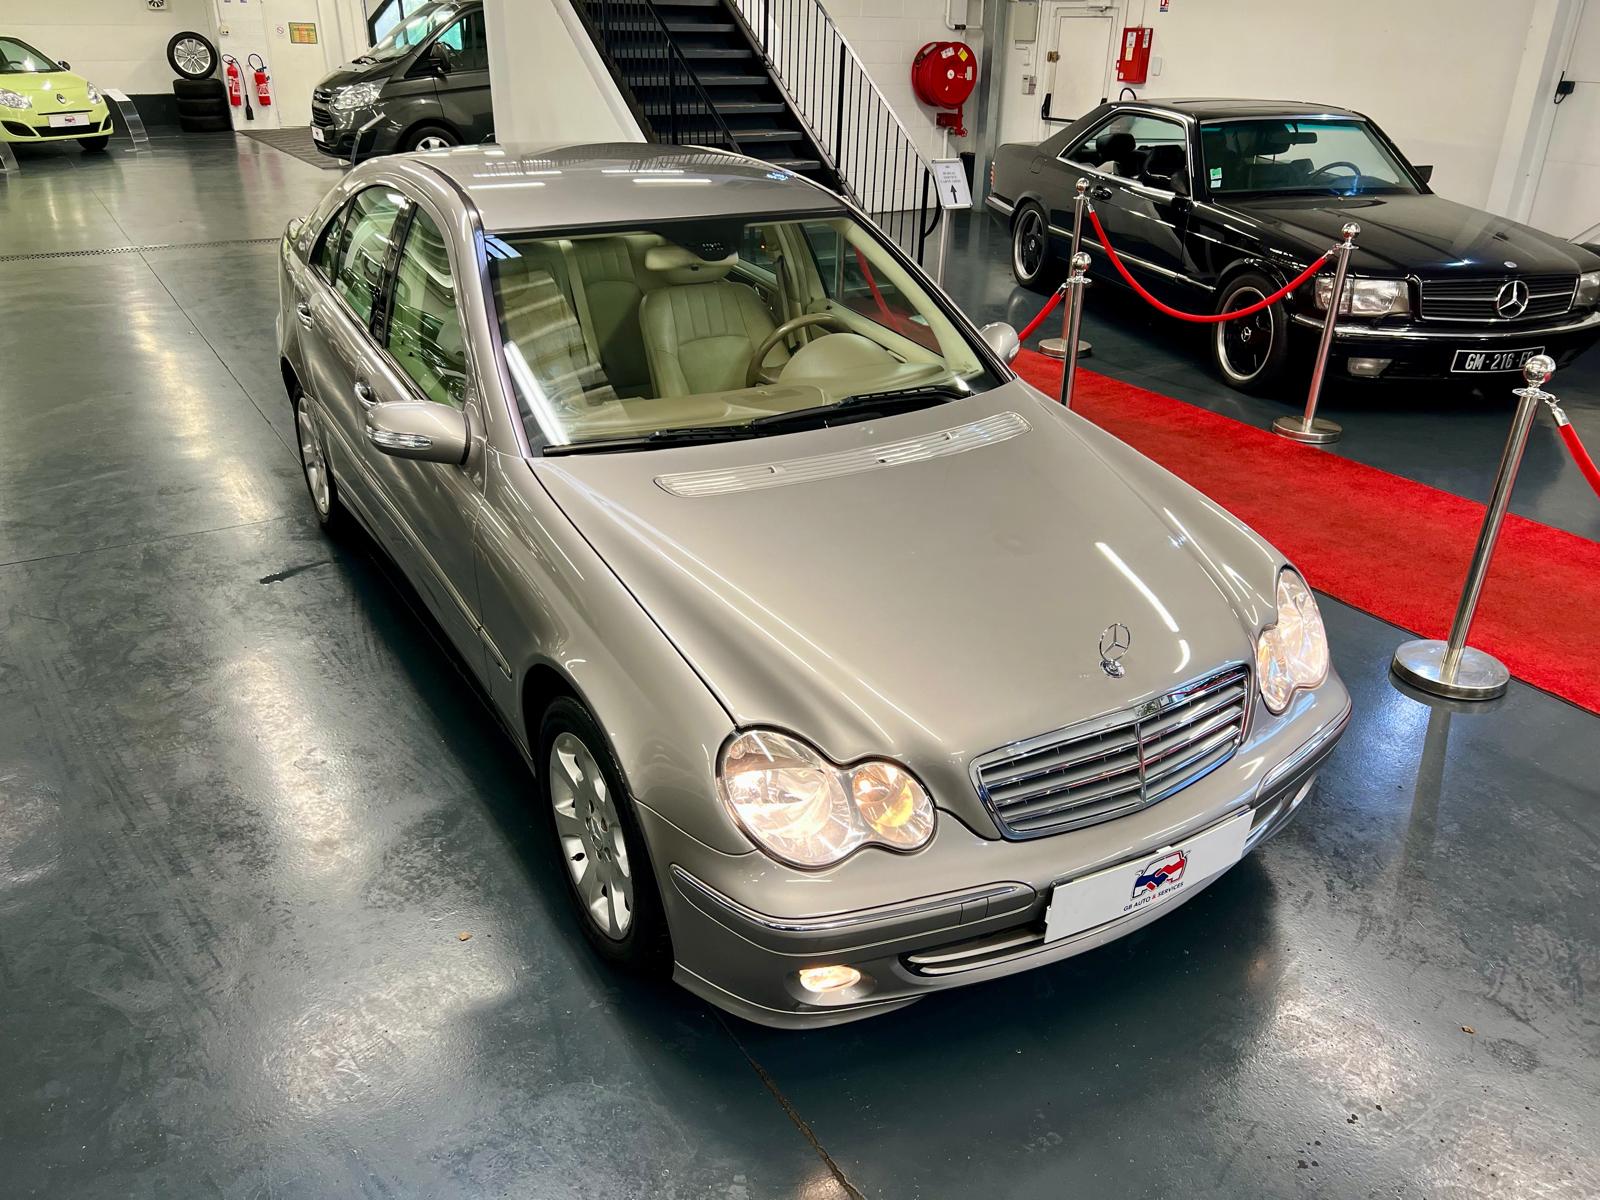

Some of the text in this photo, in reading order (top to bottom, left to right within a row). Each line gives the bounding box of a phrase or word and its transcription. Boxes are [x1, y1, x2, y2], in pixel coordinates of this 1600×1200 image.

[1465, 351, 1534, 370] GM-216-E
[1123, 903, 1133, 912] GB
[1133, 896, 1151, 908] AUTO
[1157, 881, 1184, 897] SERVICES
